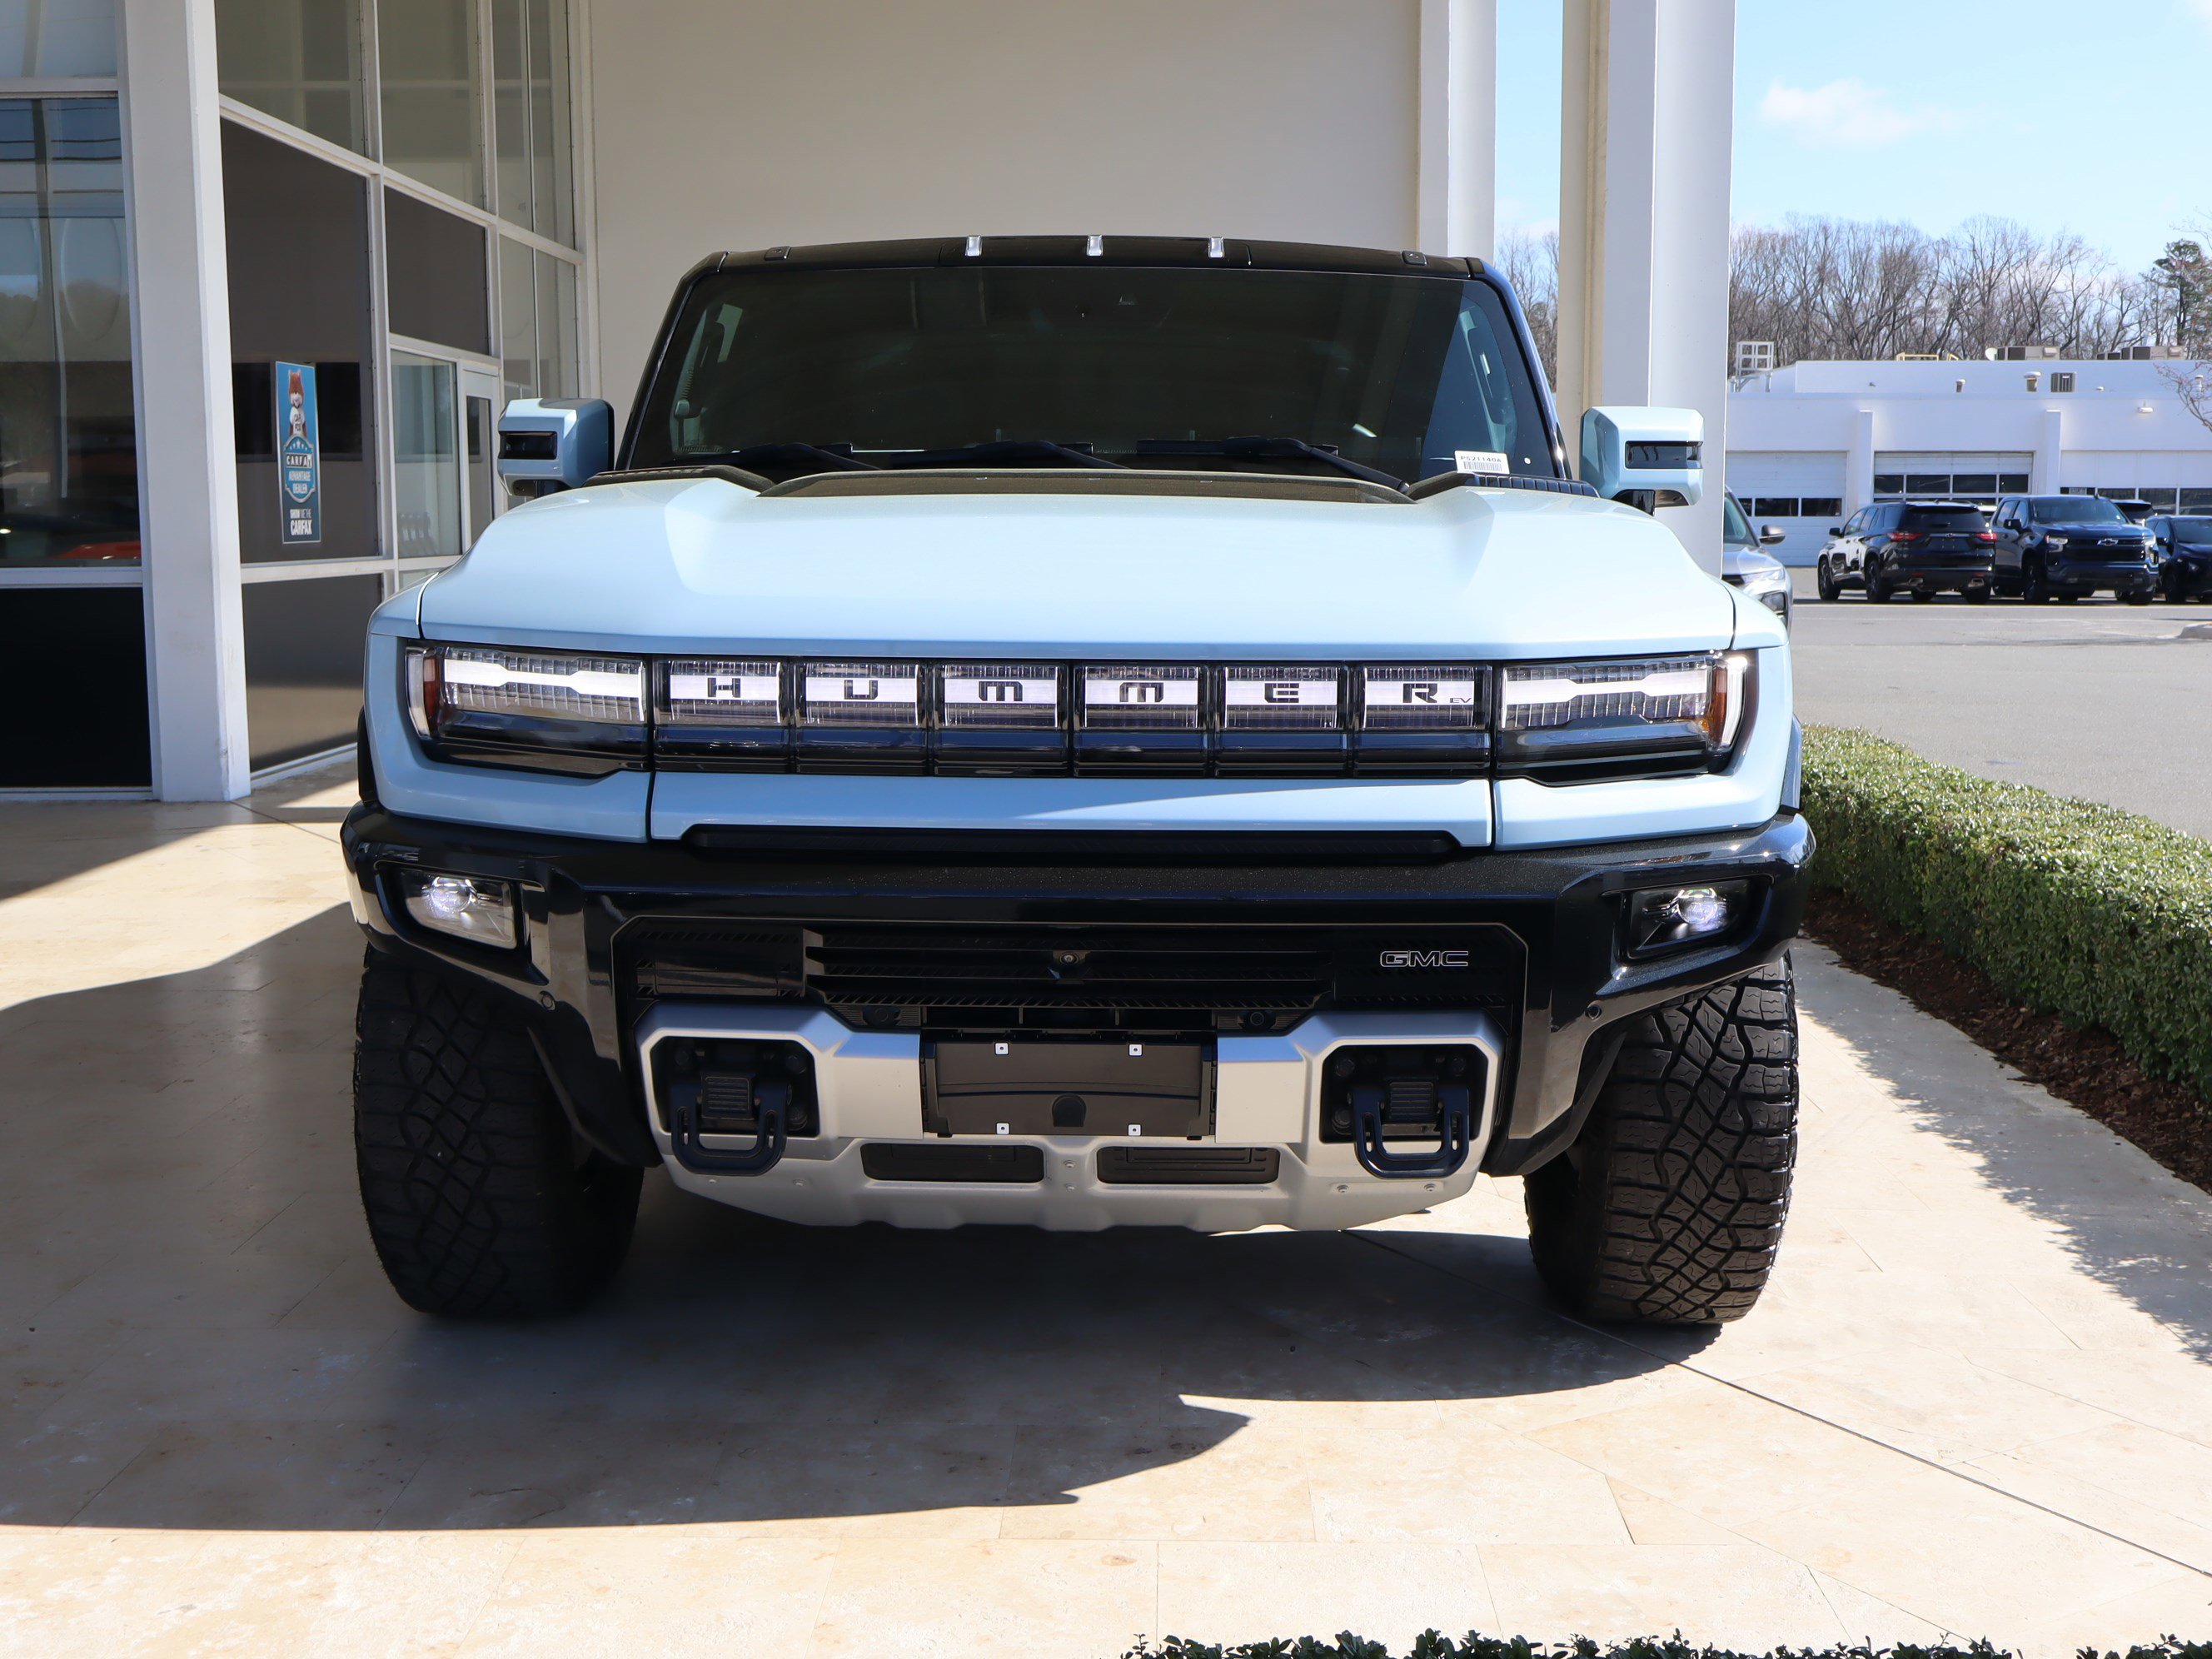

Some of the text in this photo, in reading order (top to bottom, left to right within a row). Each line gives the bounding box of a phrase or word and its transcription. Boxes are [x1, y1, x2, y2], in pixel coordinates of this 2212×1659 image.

[291, 520, 312, 535] CARFAX
[707, 677, 1437, 704] HUMMER
[1380, 951, 1468, 967] GMC
